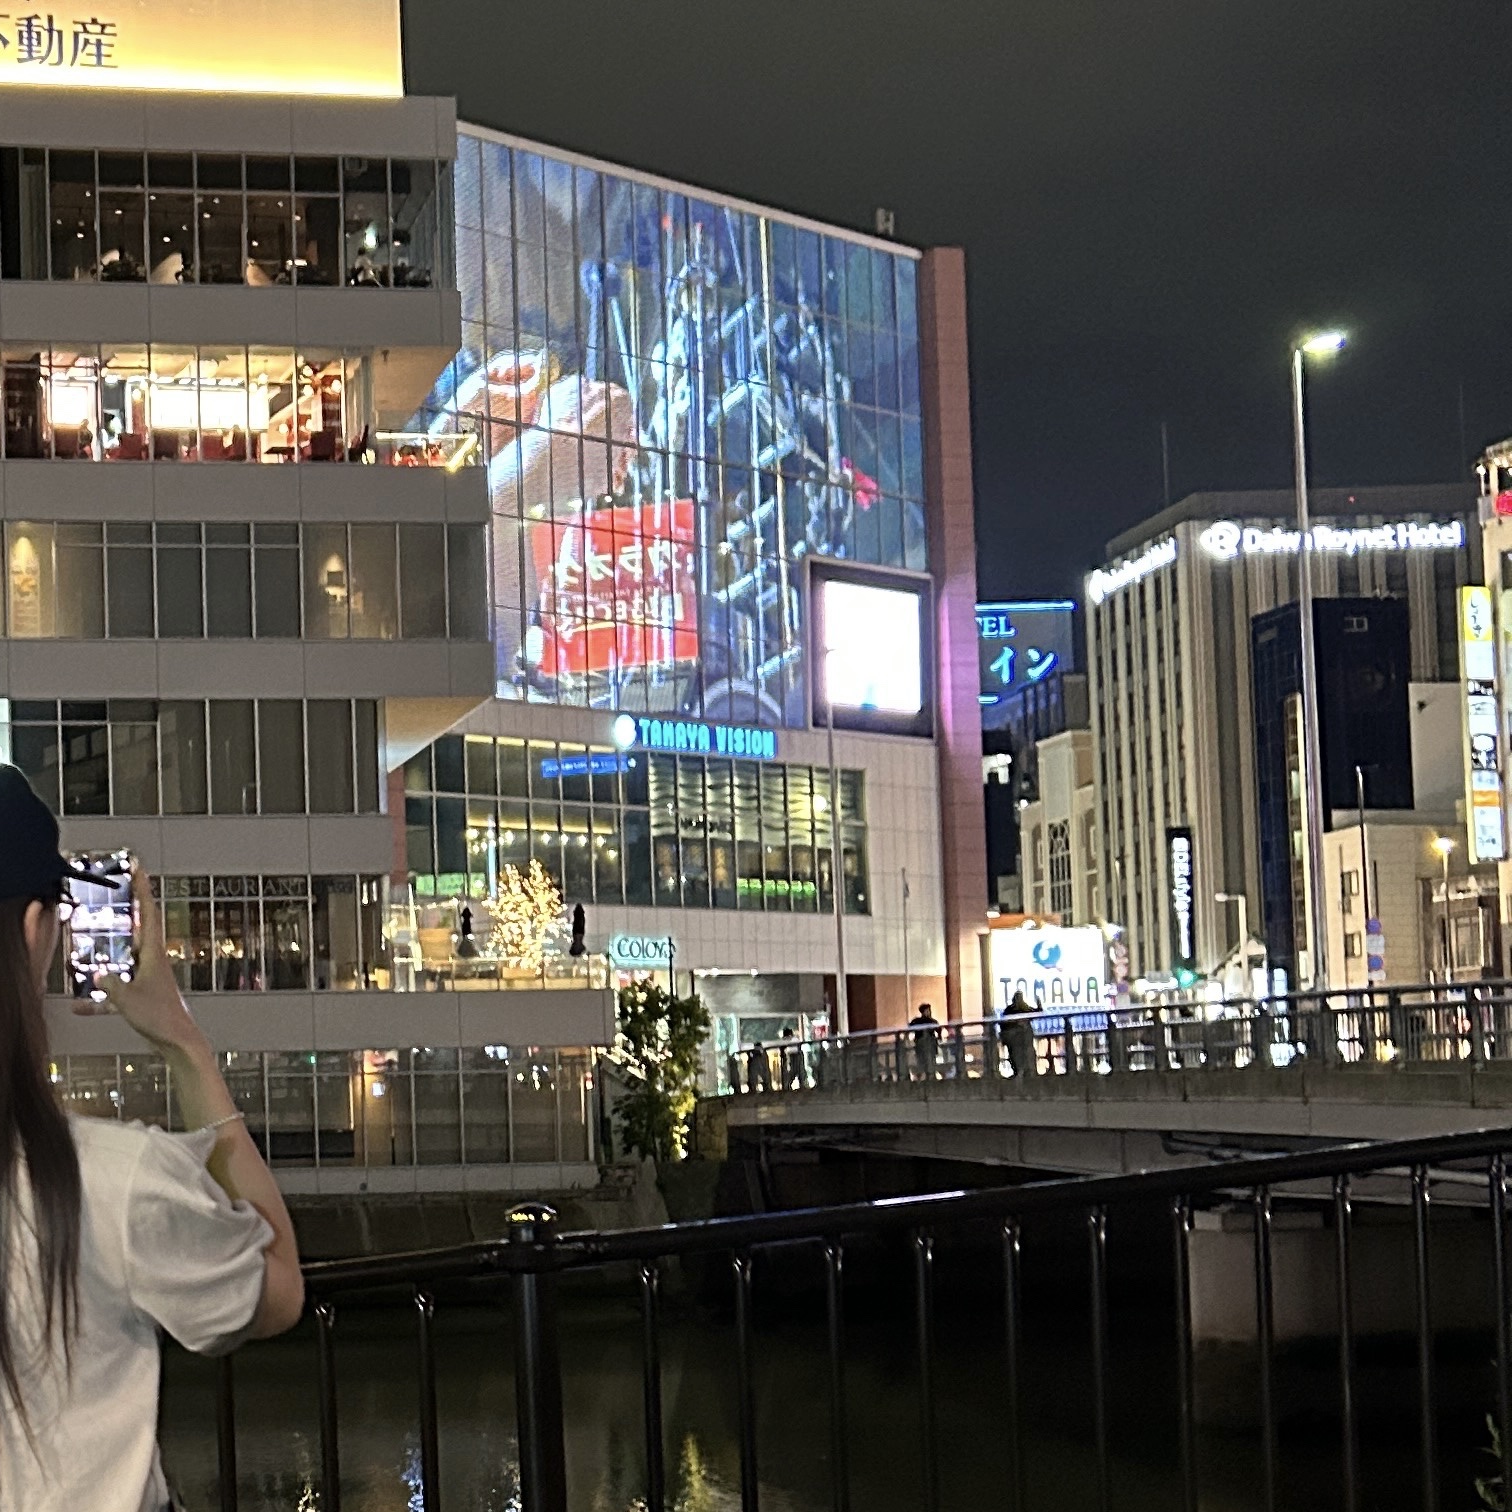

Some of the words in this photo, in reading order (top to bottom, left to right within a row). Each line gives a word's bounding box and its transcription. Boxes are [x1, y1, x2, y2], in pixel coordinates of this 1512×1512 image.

[1397, 521, 1465, 548] Hotel
[638, 718, 711, 752] TAMAYA
[715, 725, 775, 759] VISION
